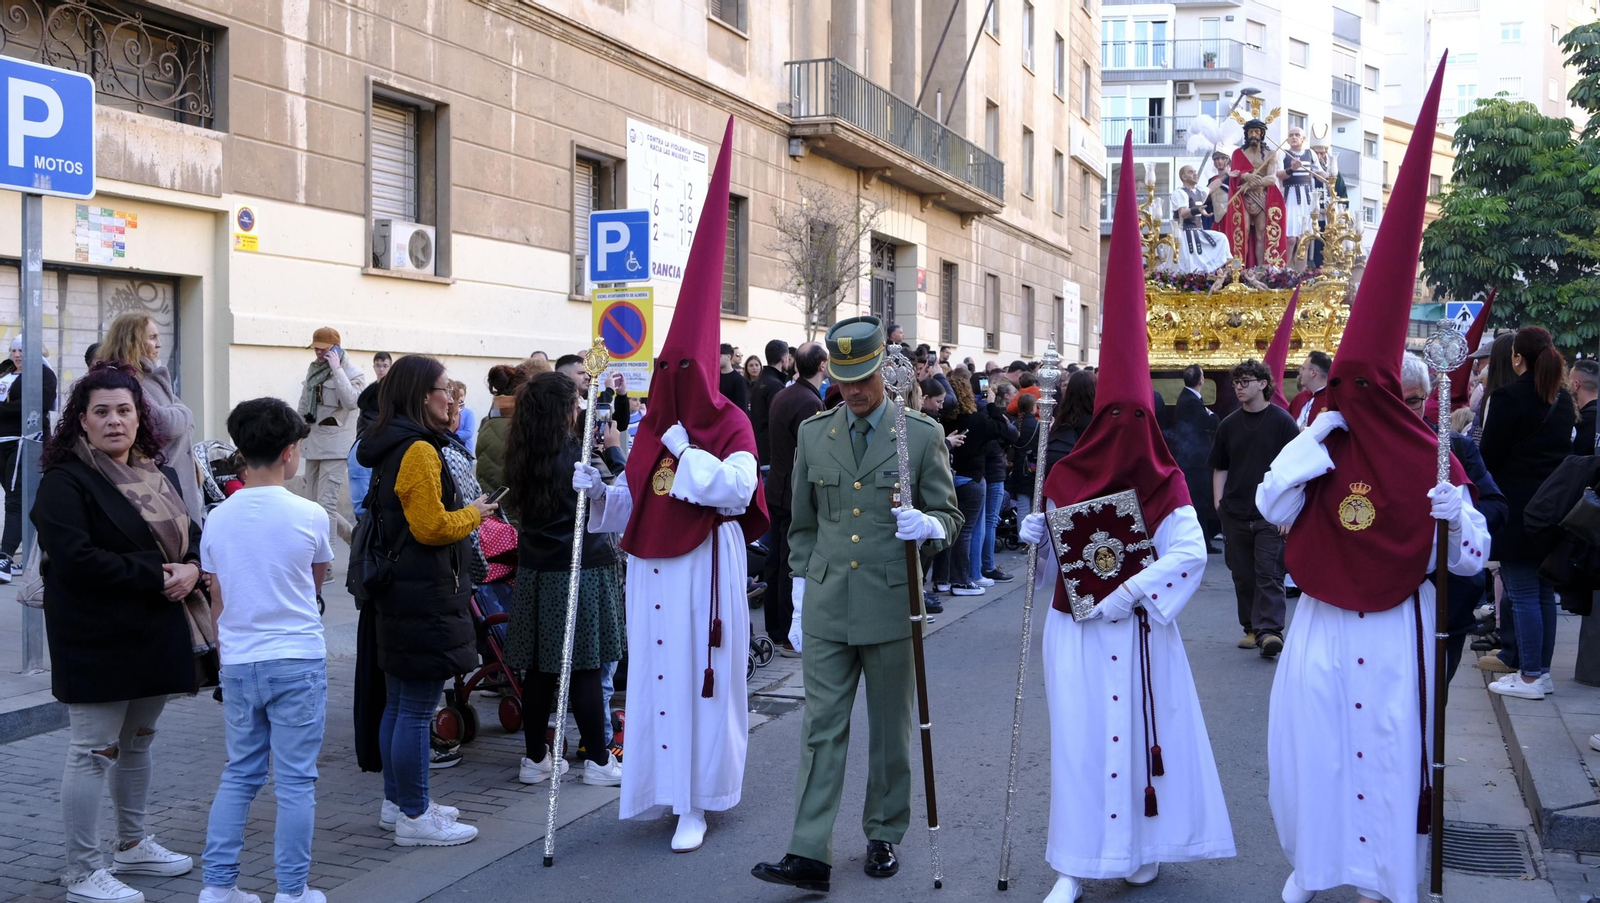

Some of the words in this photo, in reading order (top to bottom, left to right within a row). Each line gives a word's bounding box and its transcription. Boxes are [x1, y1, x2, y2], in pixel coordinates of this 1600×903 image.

[8, 76, 64, 167] P
[647, 134, 663, 145] CONTRA
[664, 140, 670, 148] LA
[670, 142, 691, 155] VIOLENCIA
[650, 143, 662, 153] HACIA
[671, 151, 689, 162] MUJERES
[34, 155, 84, 175] MOTOS
[653, 173, 660, 191] 4
[653, 198, 660, 217] 6
[679, 204, 693, 224] 58
[653, 222, 659, 241] 2
[597, 221, 631, 272] P
